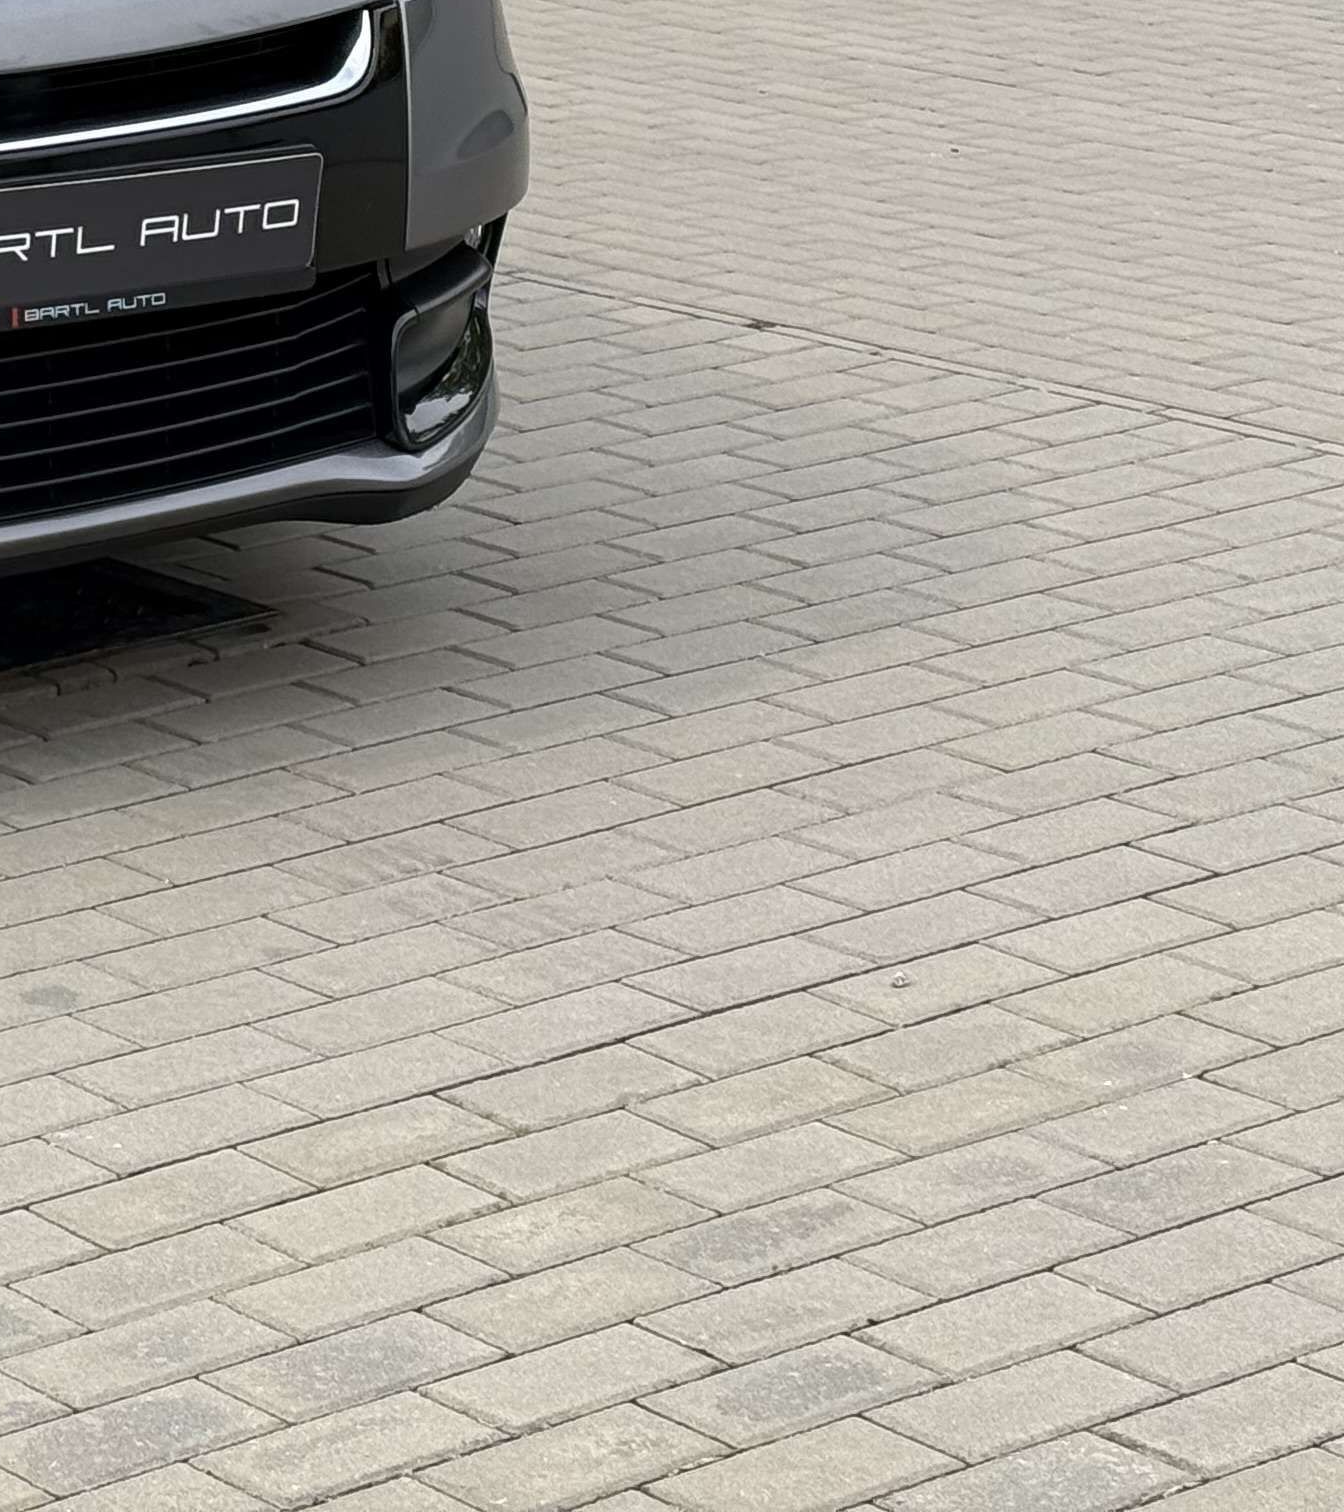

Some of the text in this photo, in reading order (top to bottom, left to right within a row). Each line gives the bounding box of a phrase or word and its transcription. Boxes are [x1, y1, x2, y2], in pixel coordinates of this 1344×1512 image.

[140, 198, 300, 247] AUTO
[24, 292, 166, 322] BARTL AUTO
